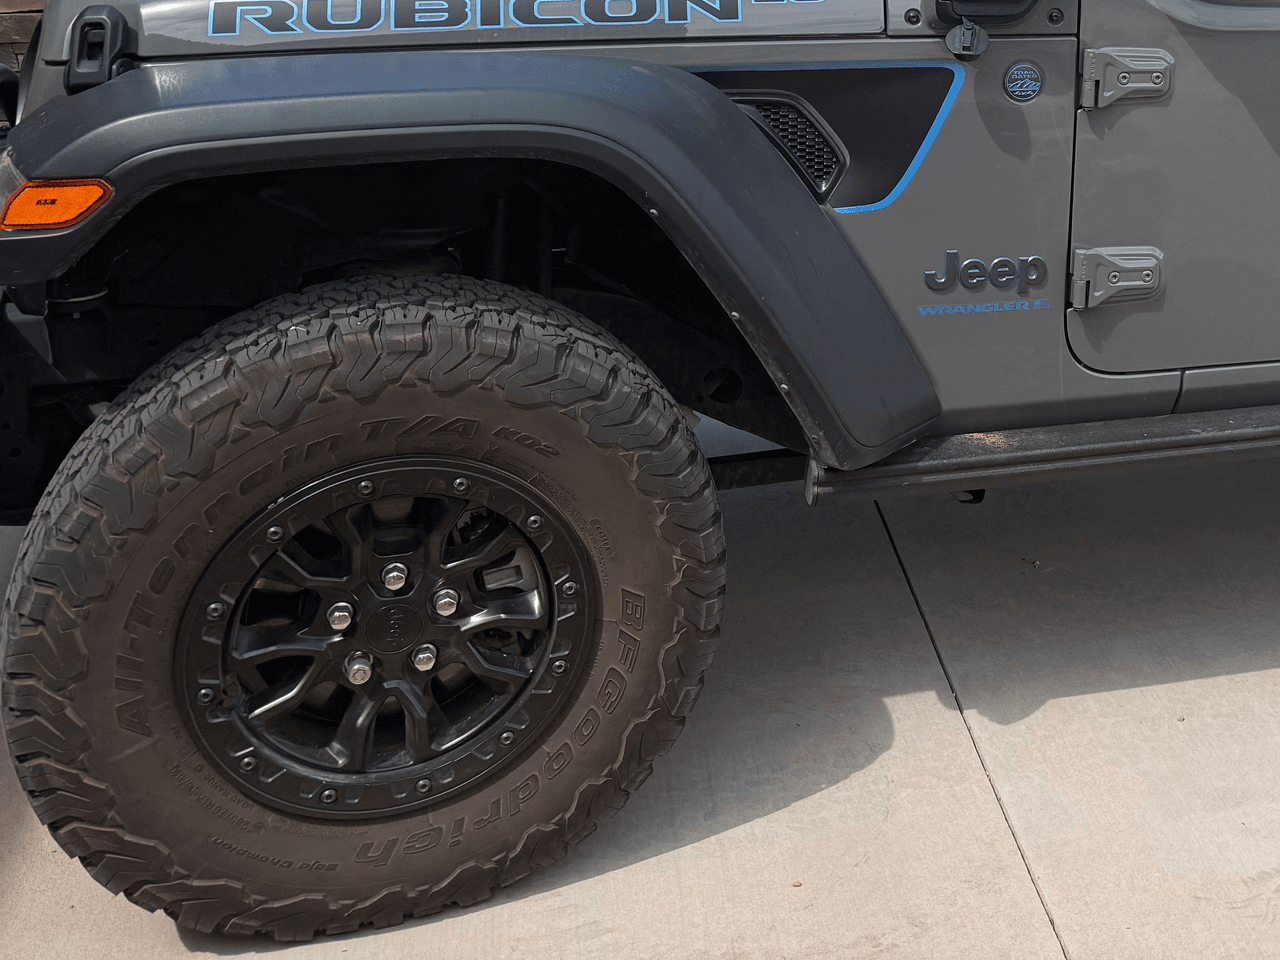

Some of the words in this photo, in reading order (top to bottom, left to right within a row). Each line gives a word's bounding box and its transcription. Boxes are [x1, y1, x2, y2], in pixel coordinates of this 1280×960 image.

[924, 248, 1048, 296] Jeep
[917, 301, 1030, 317] WRANGLER
[359, 414, 480, 441] T/A
[353, 587, 645, 868] BFGoodrich
[230, 793, 254, 812] LOAD
[211, 836, 295, 870] Champion
